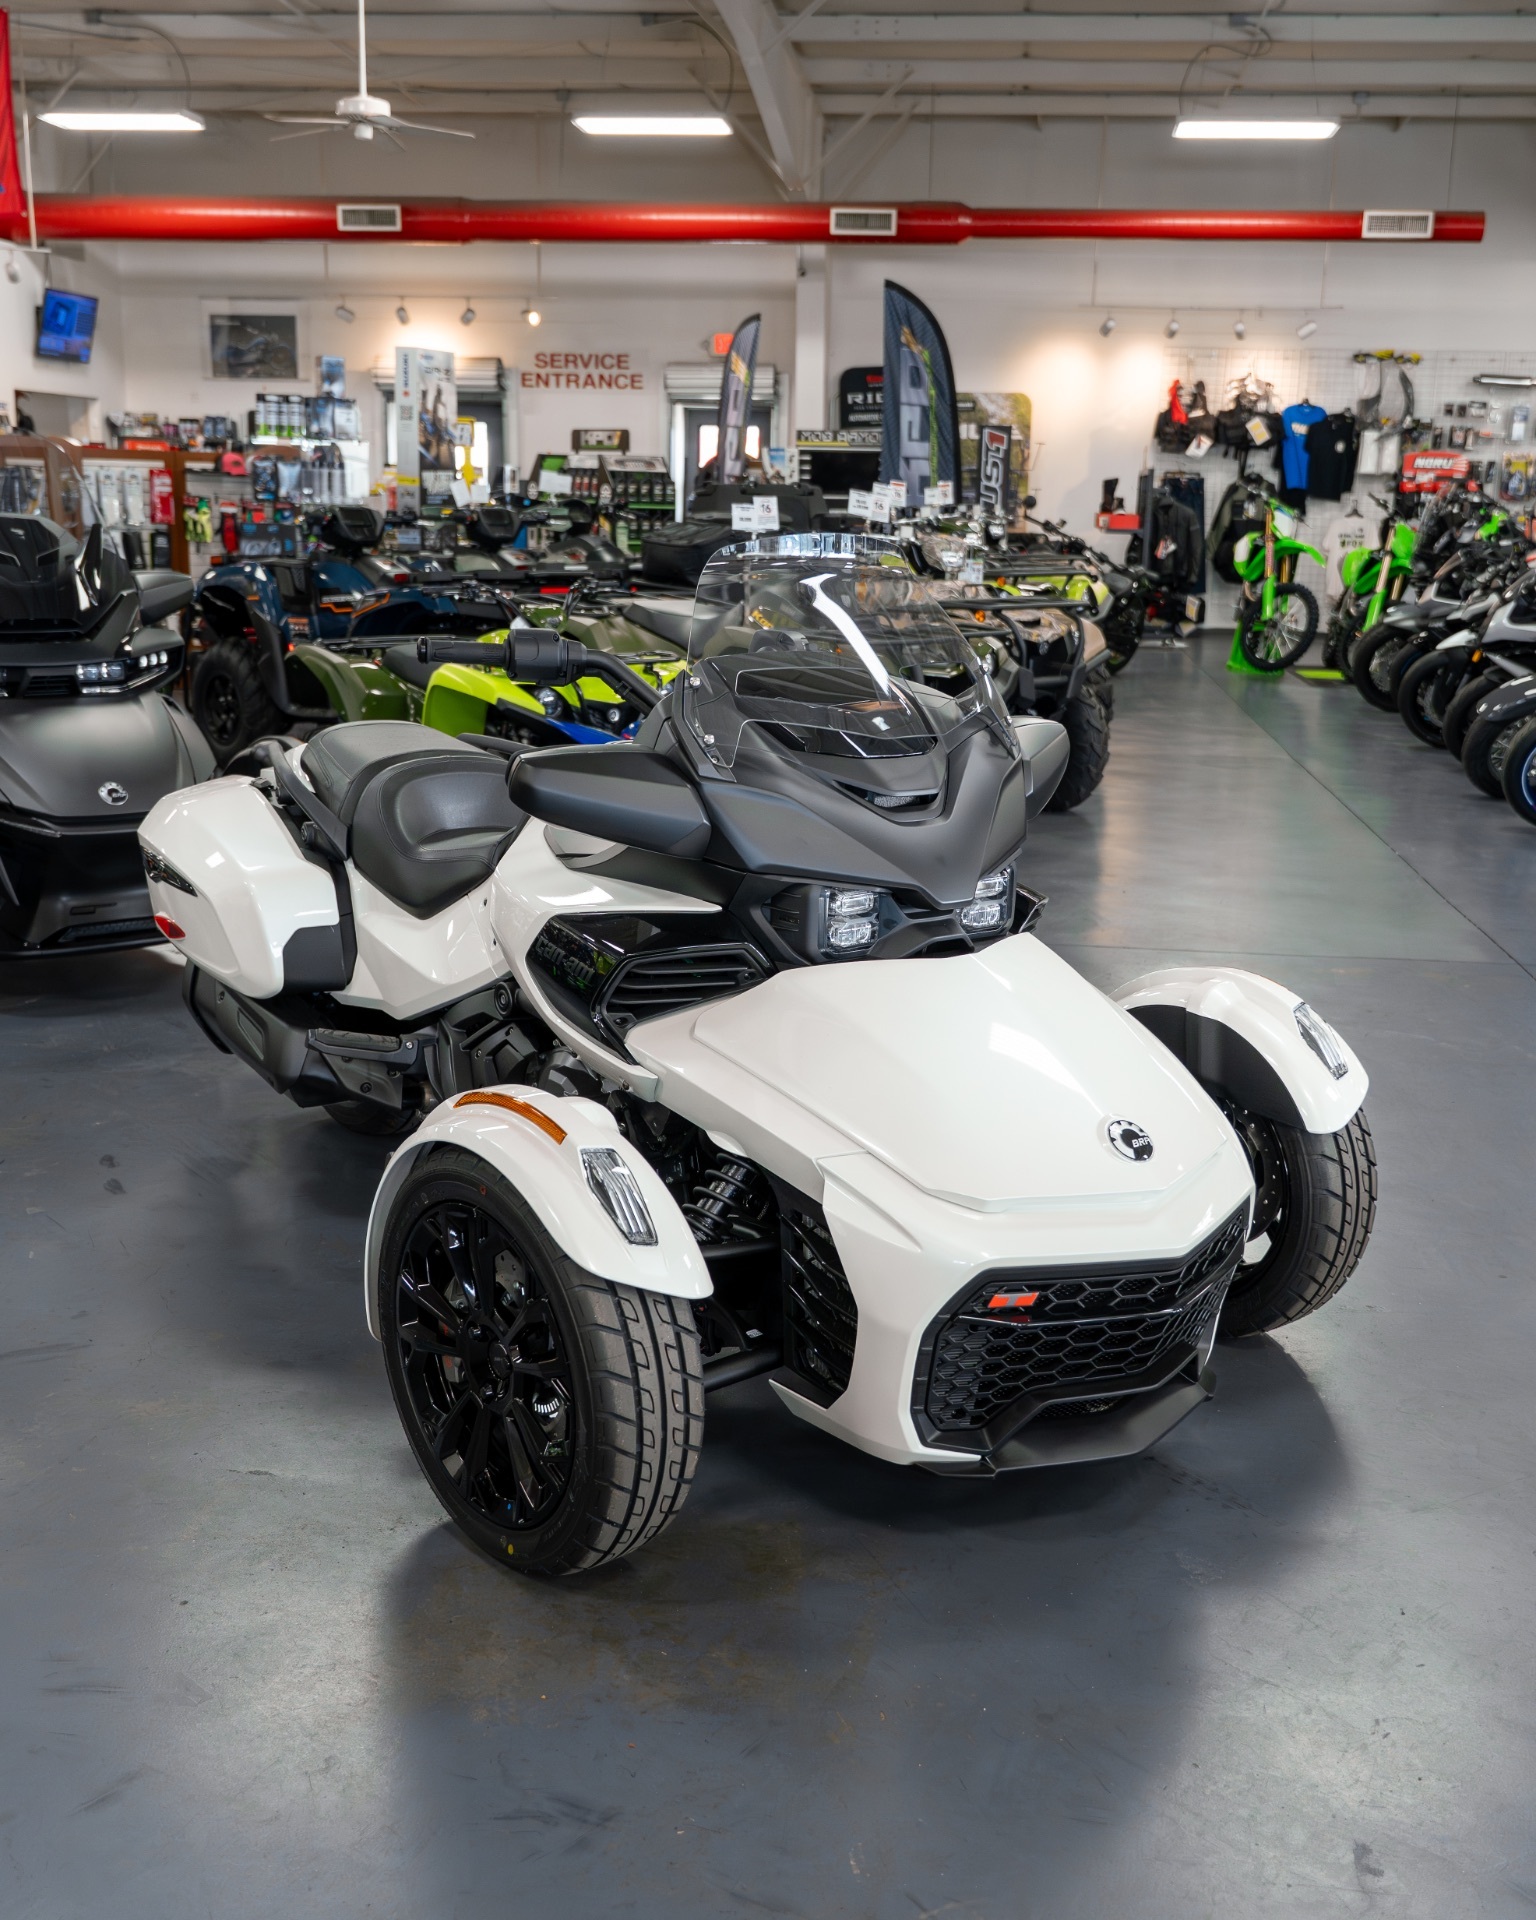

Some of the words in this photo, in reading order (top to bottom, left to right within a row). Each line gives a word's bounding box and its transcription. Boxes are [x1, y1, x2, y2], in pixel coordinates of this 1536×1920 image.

[534, 352, 629, 370] SERVICE
[520, 371, 644, 390] ENTRANCE
[800, 431, 833, 442] MOB
[836, 431, 882, 443] ARMO
[1131, 1136, 1151, 1148] BRP
